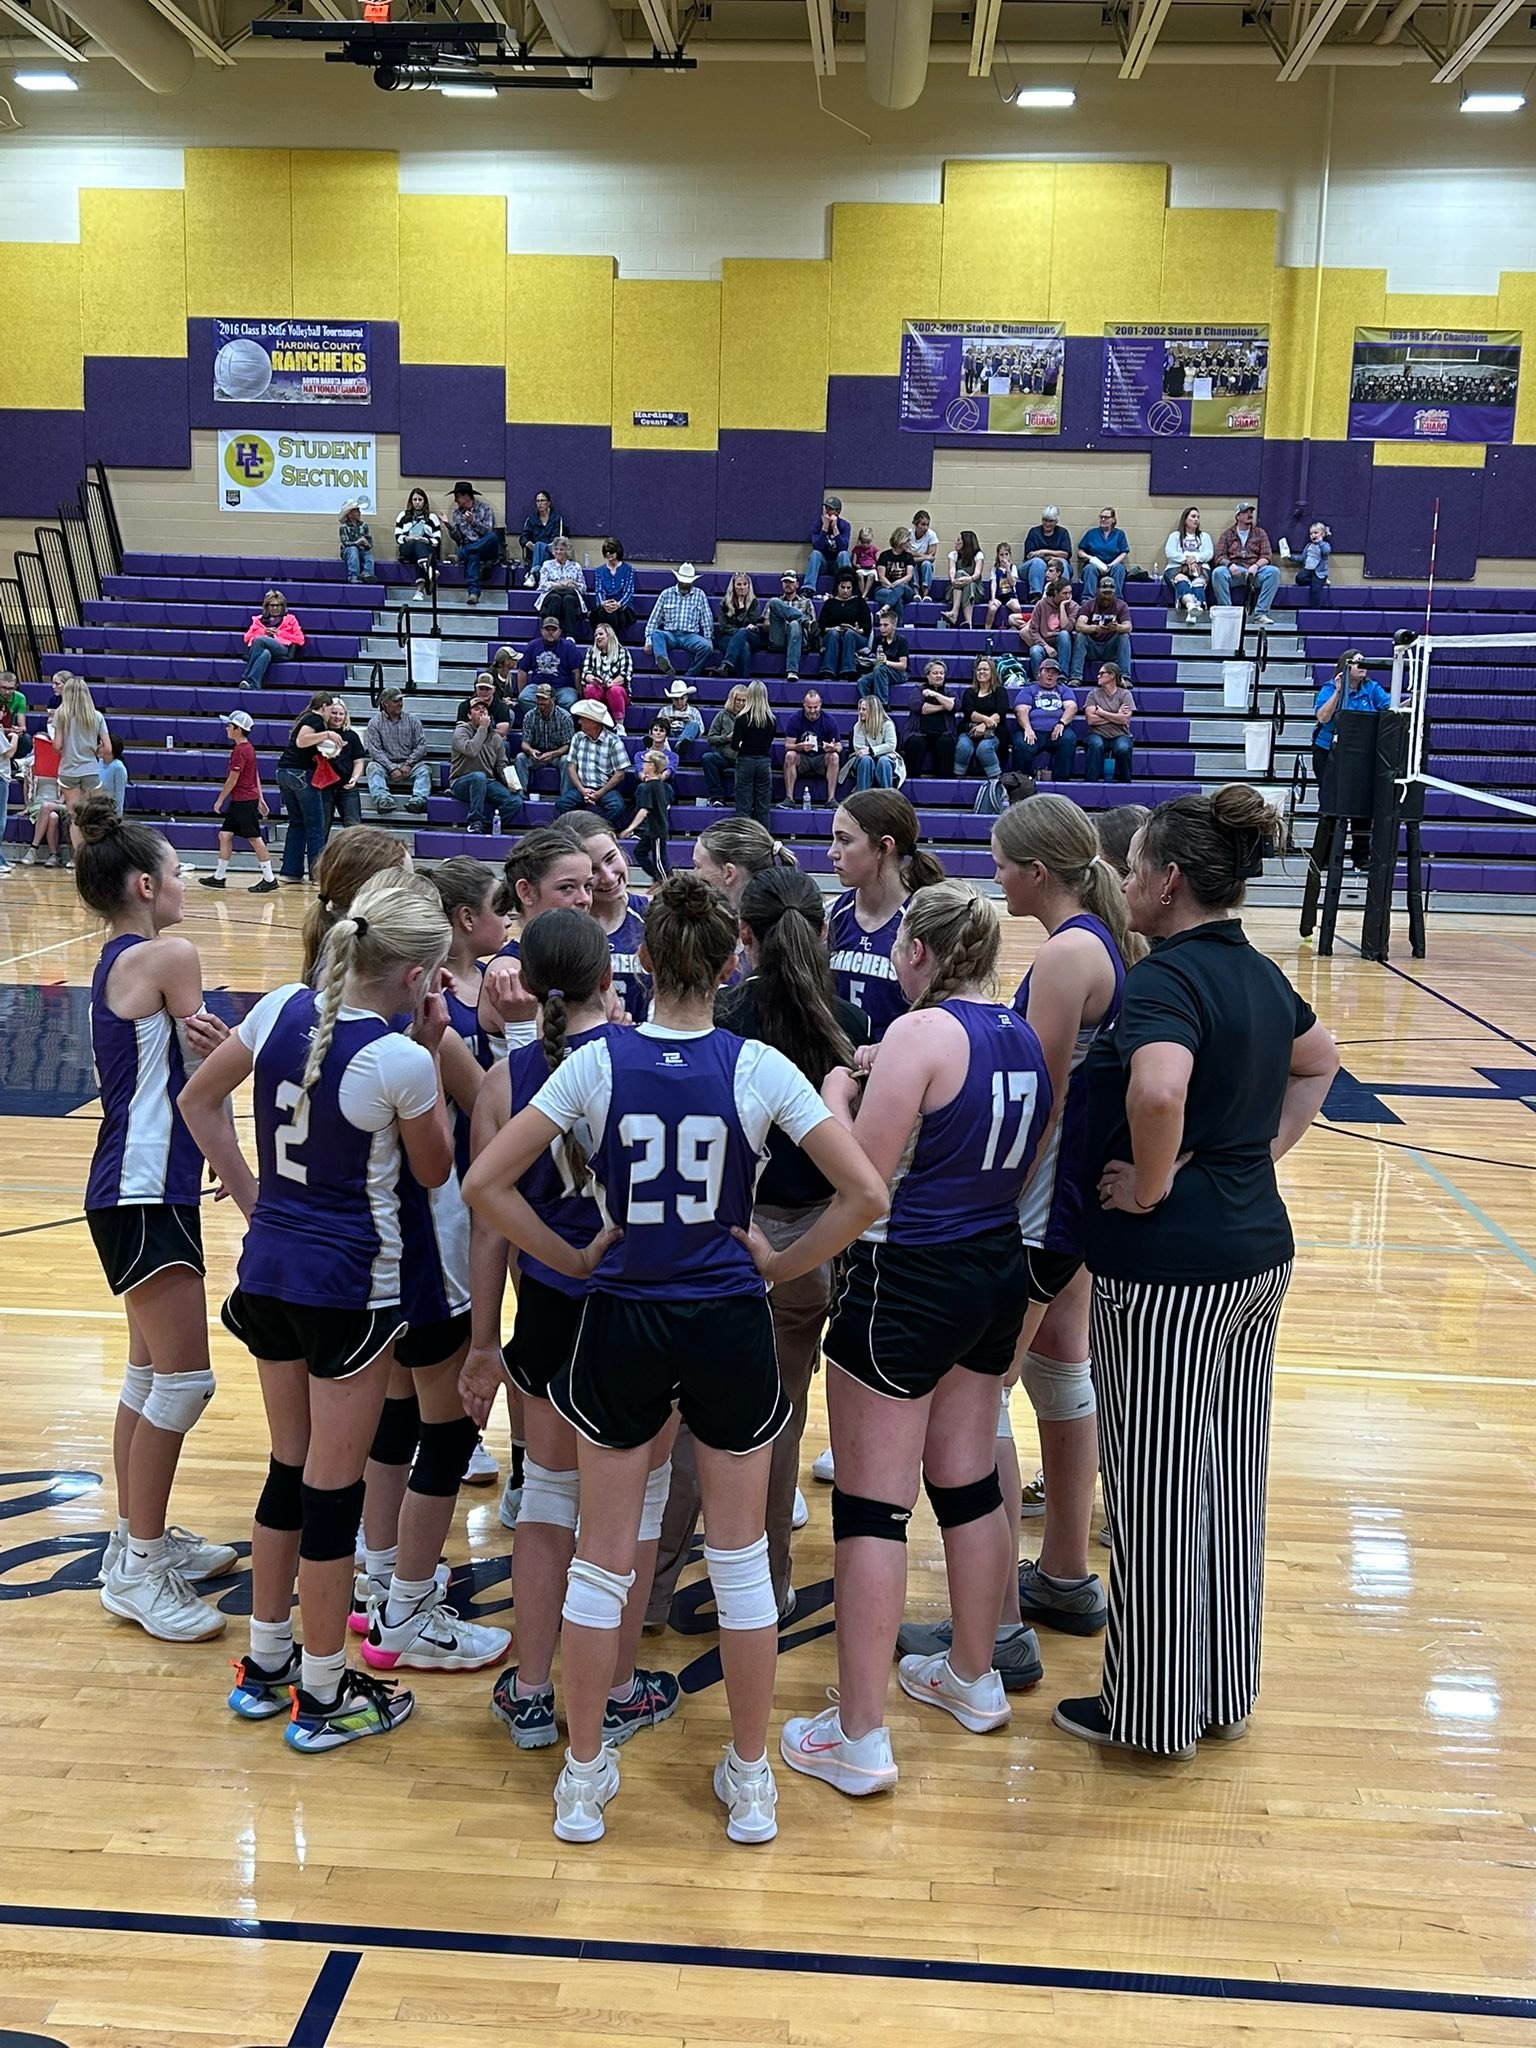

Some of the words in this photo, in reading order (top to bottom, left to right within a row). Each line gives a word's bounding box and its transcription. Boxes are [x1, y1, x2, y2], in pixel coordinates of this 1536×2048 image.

[219, 323, 240, 335] 2016
[241, 323, 260, 336] Class
[261, 323, 267, 336] B
[268, 323, 287, 336] State
[287, 324, 321, 338] Volleyball
[322, 325, 364, 338] Tournament
[912, 322, 965, 333] 2002-2003
[966, 323, 992, 334] State
[1002, 324, 1056, 335] Champions
[1115, 326, 1166, 336] 2001-2002
[1167, 326, 1194, 336] State
[1203, 326, 1259, 337] Champions
[1421, 331, 1442, 341] State
[1443, 332, 1489, 342] Champions
[271, 351, 366, 372] RANCHERS
[303, 385, 339, 394] NATIONAL
[341, 385, 367, 395] GUARD
[278, 436, 371, 460] STUDENT
[236, 442, 264, 478] HC
[281, 465, 368, 488] SECTION
[859, 936, 872, 951] HC
[980, 1071, 1038, 1171] 17
[274, 1079, 311, 1186] 2
[618, 1113, 729, 1225] 29
